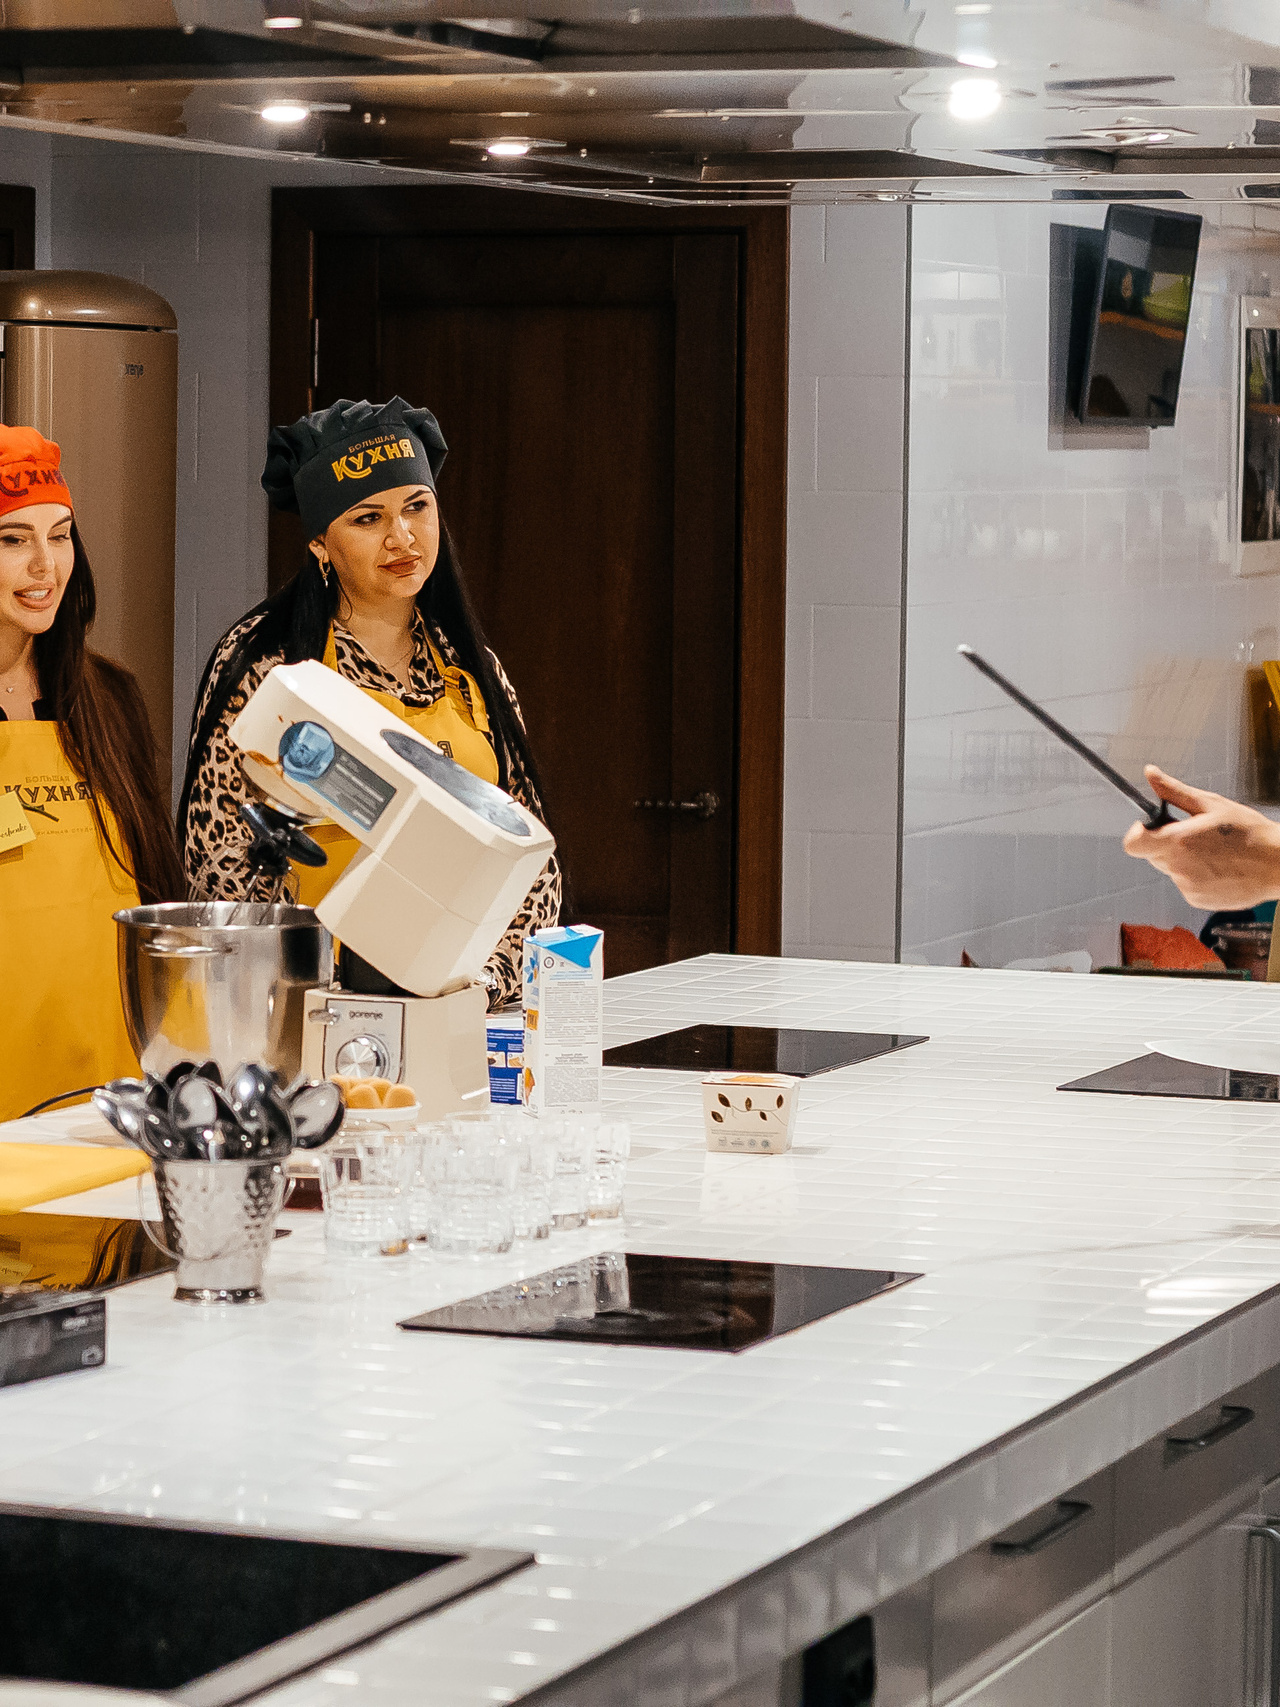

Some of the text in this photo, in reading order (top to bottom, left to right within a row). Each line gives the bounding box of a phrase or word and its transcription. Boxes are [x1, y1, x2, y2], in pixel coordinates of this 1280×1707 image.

[348, 434, 396, 453] БОЛЬШАЯ
[331, 438, 416, 482] КУХНЯ
[348, 1010, 383, 1020] gorenje
